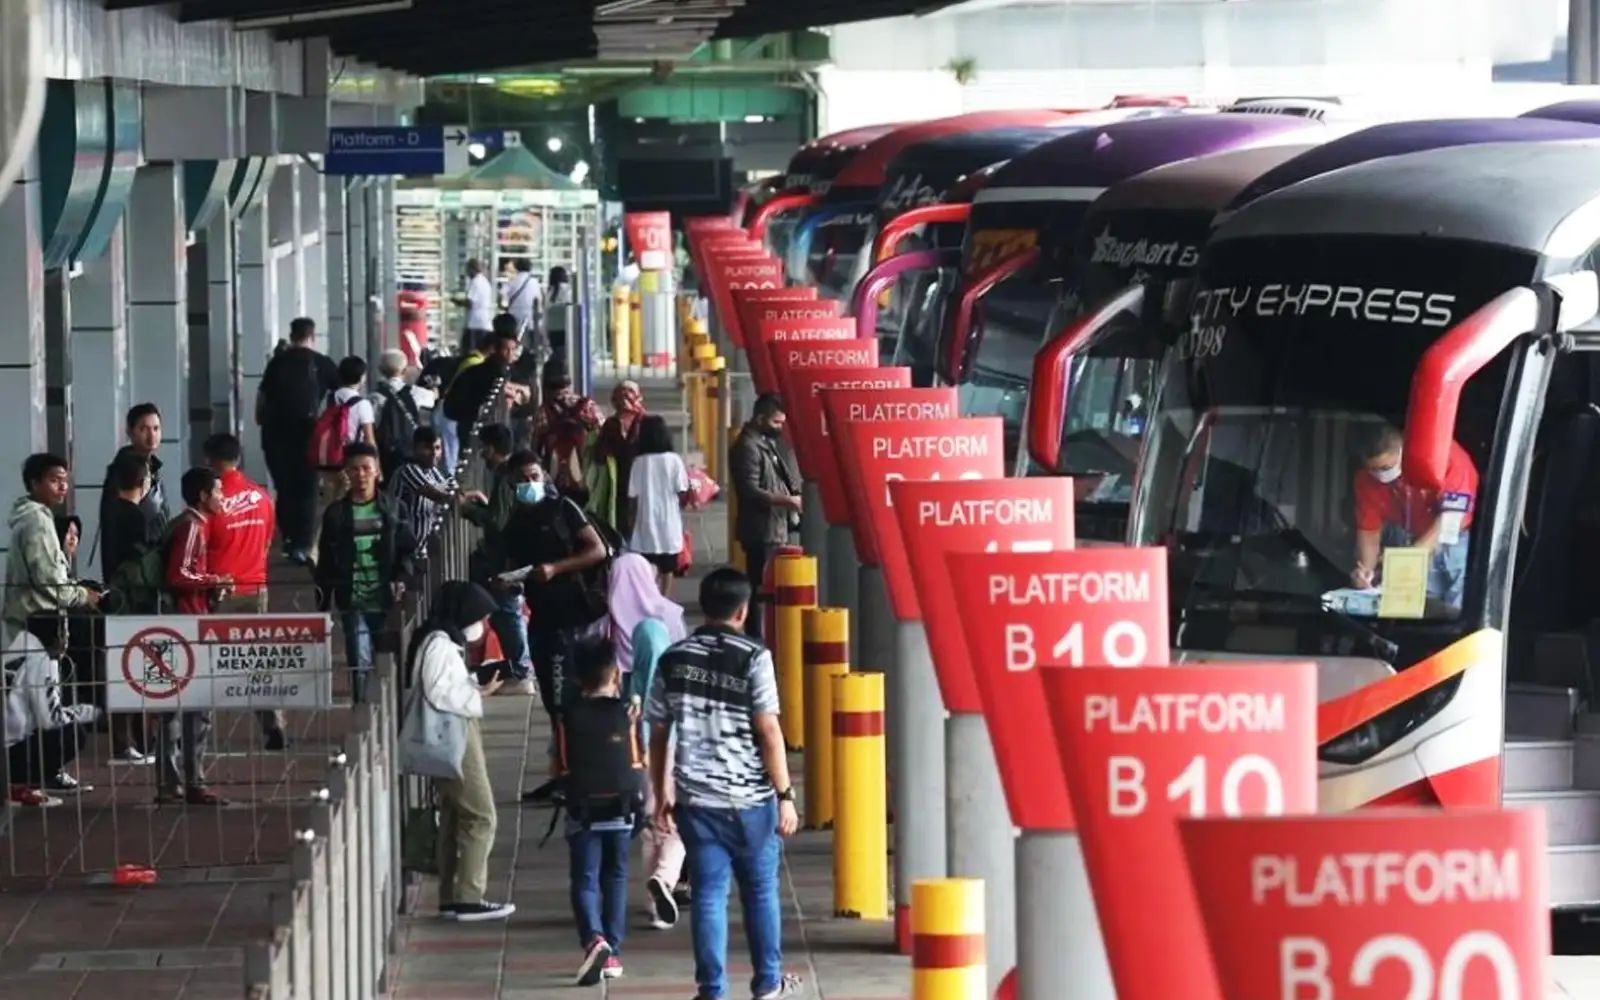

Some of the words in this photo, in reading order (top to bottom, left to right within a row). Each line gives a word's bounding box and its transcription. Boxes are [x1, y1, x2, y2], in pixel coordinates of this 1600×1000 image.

[331, 132, 395, 146] Platform
[407, 132, 420, 146] D
[724, 265, 777, 277] PLATFORM
[1255, 283, 1457, 327] EXPRESS
[788, 350, 870, 367] PLATFORM
[849, 403, 950, 421] PLATFORM
[872, 435, 989, 460] PLATFORM
[918, 498, 1054, 526] PLATFORM
[988, 571, 1150, 605] PLATFORM
[219, 645, 304, 658] DILARANG
[1005, 623, 1037, 673] B
[225, 685, 299, 698] CLIMBING
[251, 673, 273, 685] NO
[1084, 693, 1285, 734] PLATFORM
[1108, 755, 1148, 817] B
[1250, 849, 1523, 908] PLATFORM
[1279, 935, 1335, 1000] B
